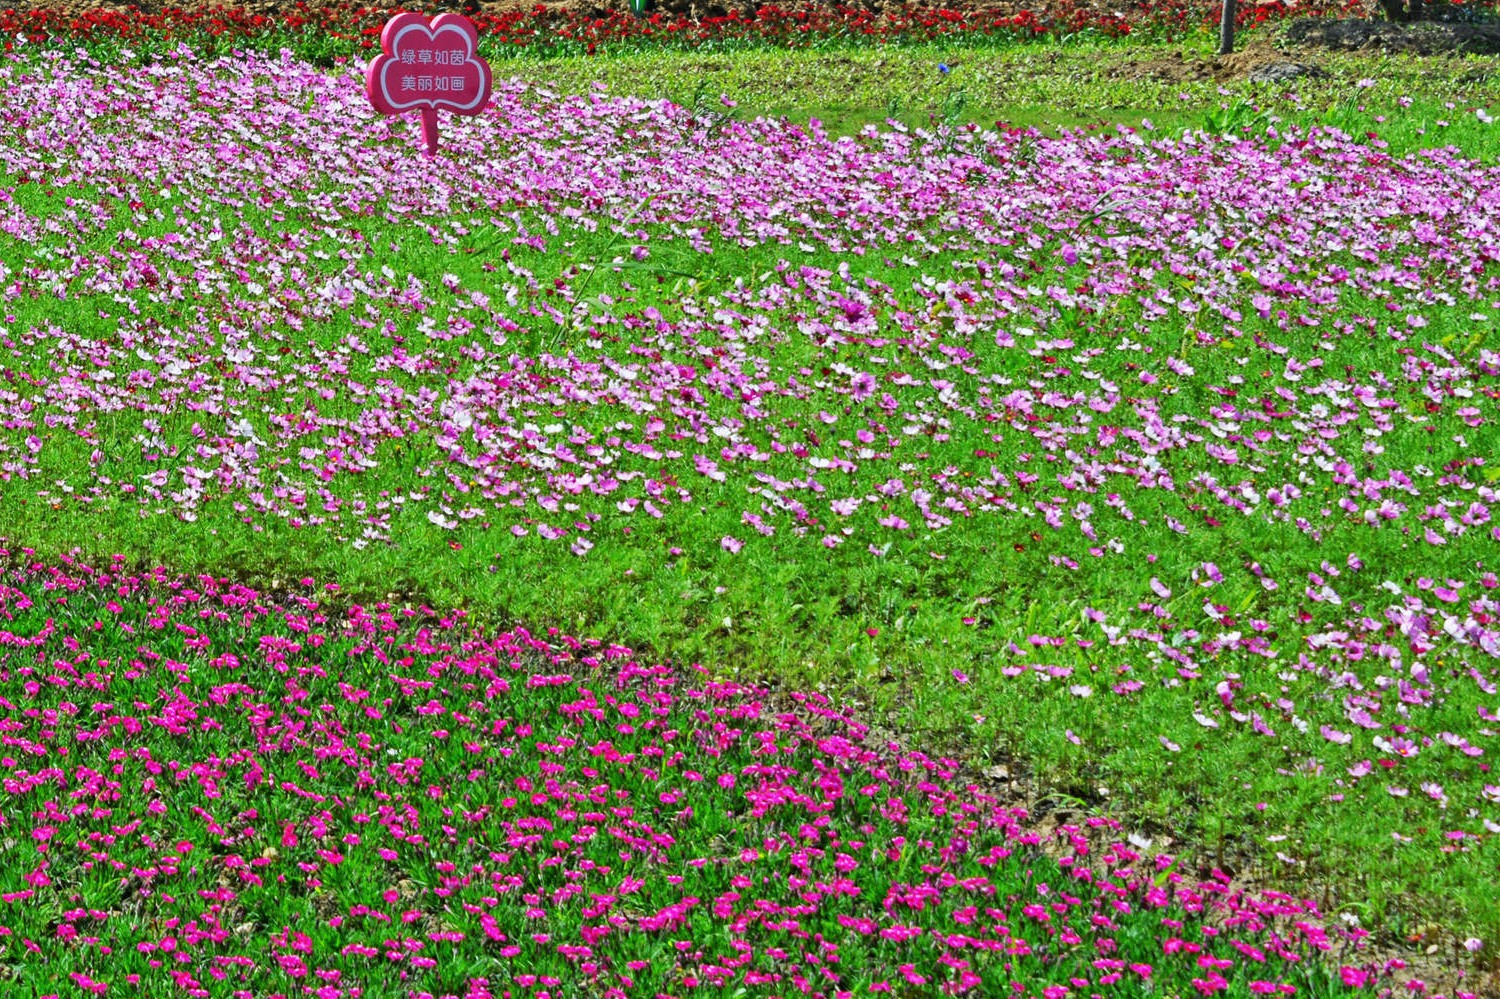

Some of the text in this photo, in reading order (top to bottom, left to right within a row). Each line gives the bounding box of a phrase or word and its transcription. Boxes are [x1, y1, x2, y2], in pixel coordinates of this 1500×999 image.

[401, 49, 465, 66] 绿草如茵
[401, 75, 465, 92] 美丽如画
